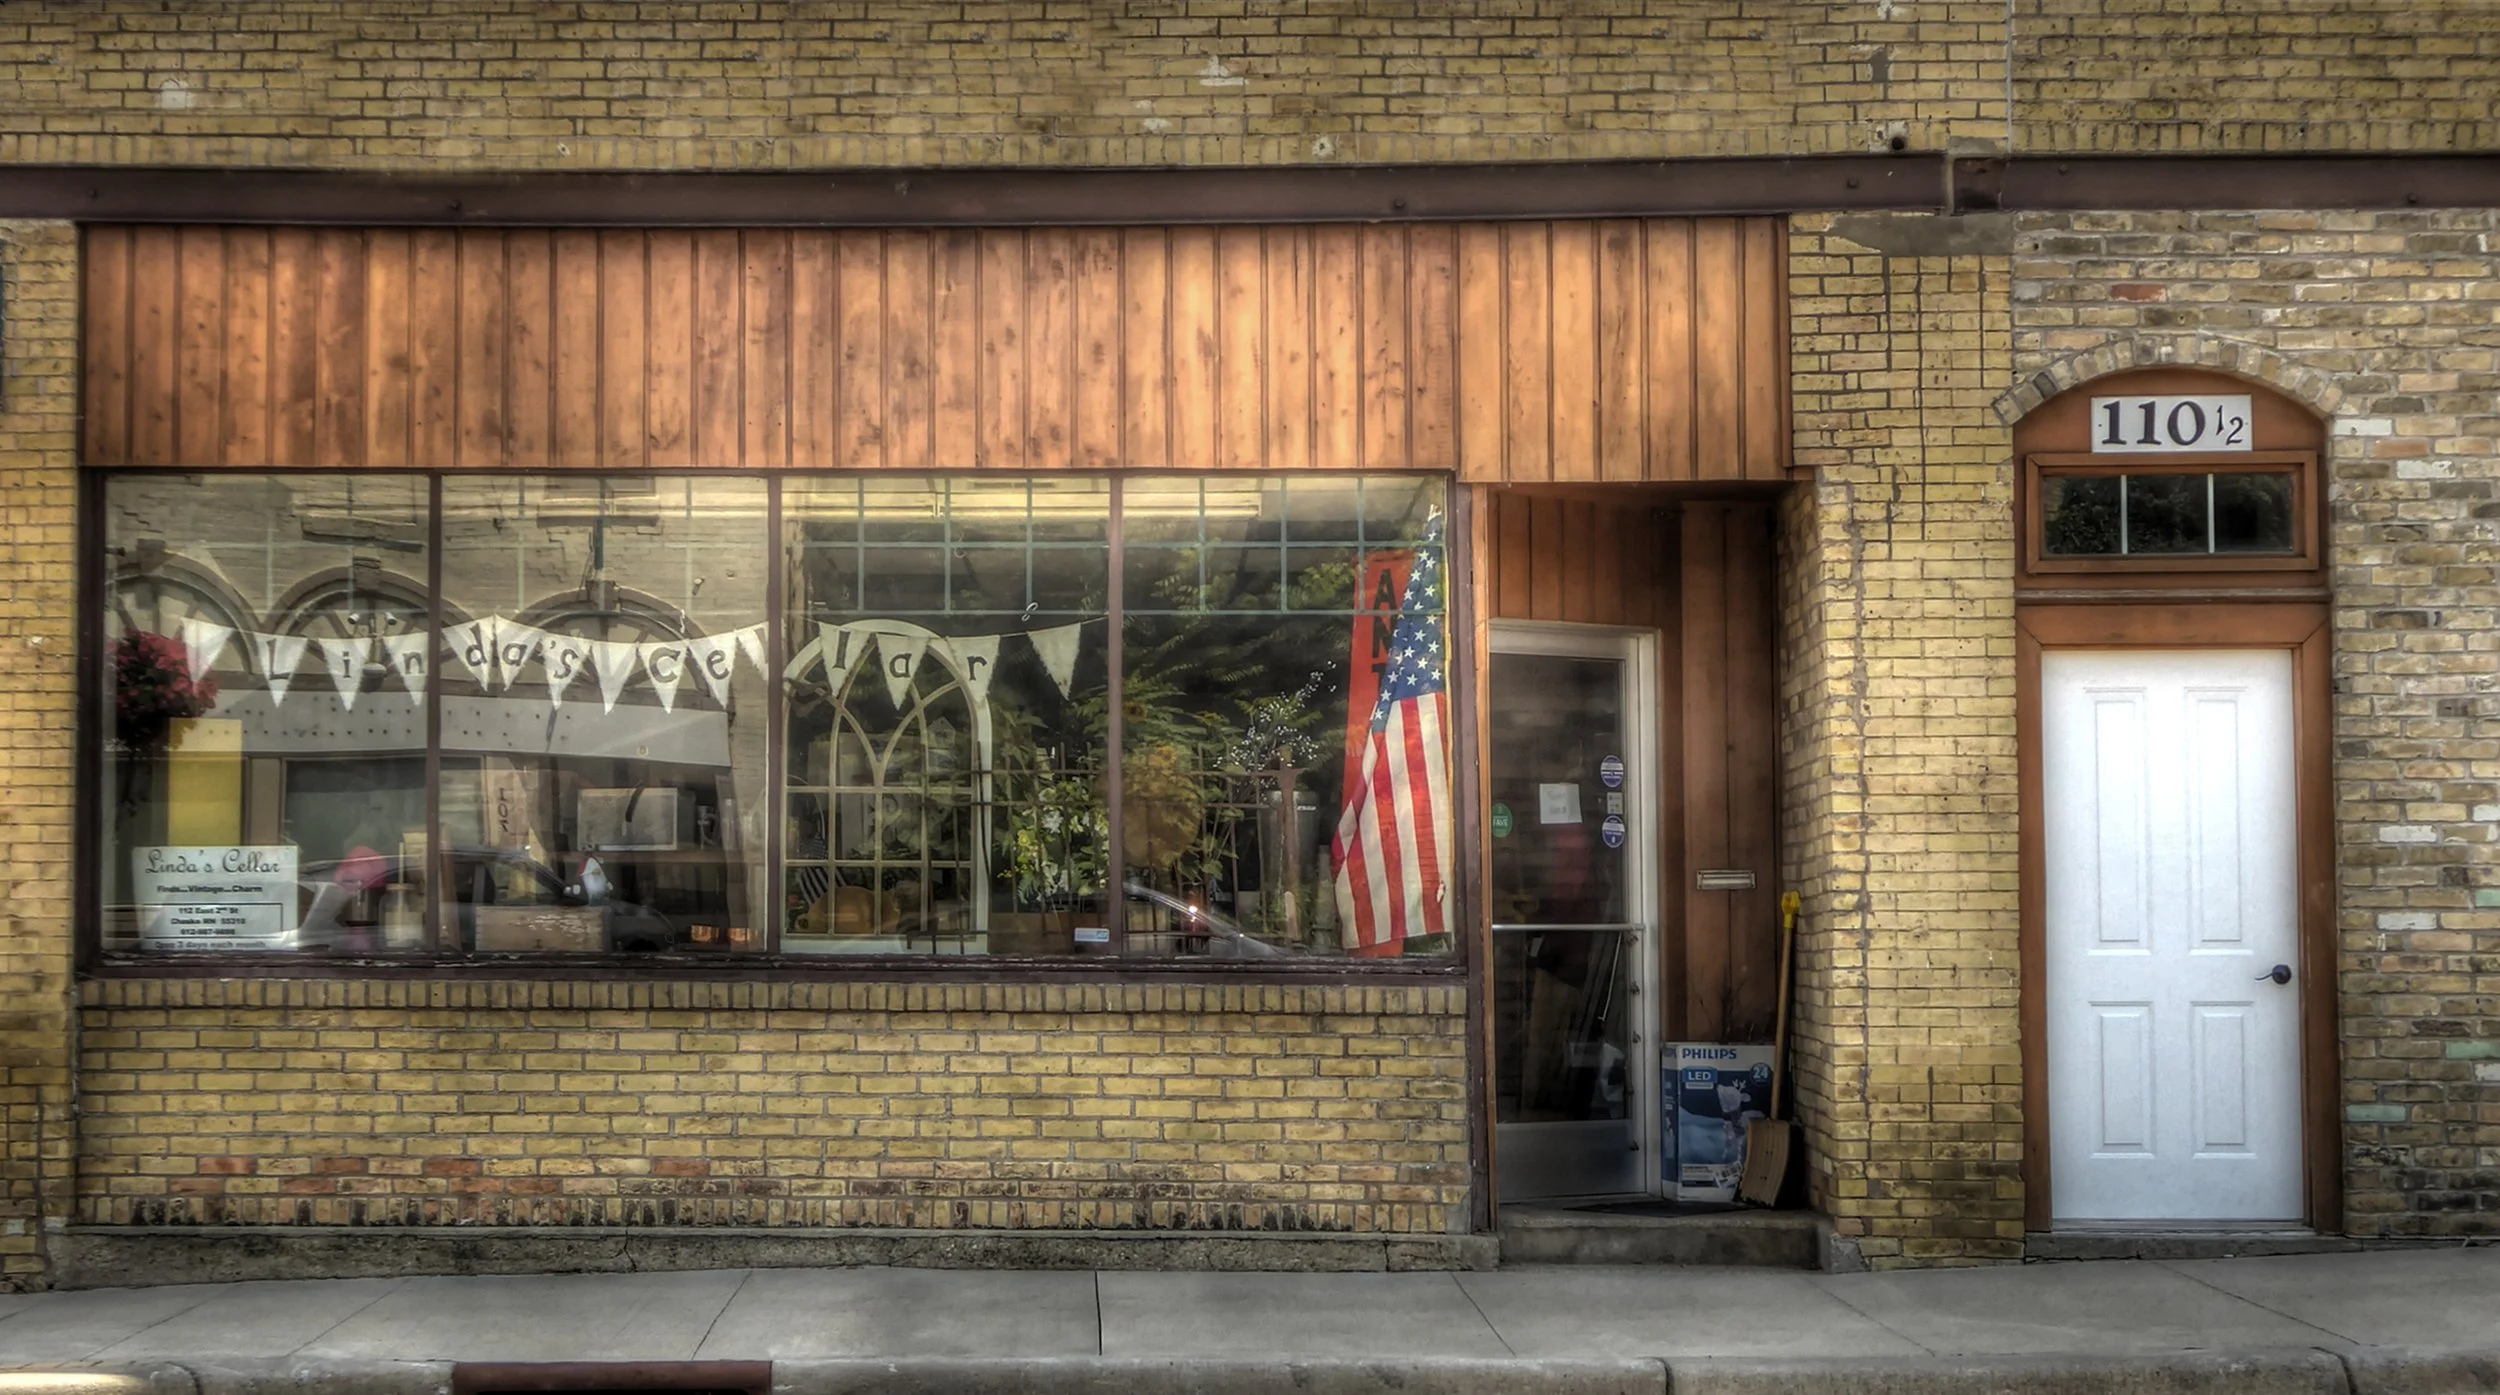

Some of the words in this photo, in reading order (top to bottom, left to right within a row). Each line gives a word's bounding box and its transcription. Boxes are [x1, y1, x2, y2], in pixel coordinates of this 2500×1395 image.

[2101, 400, 2206, 446] 110
[266, 622, 579, 682] Linda's
[145, 848, 214, 873] Linda's
[222, 848, 280, 873] Cellar
[1682, 1047, 1737, 1060] PHILIPS
[1687, 1070, 1712, 1081] LED
[1752, 1066, 1769, 1080] 24
